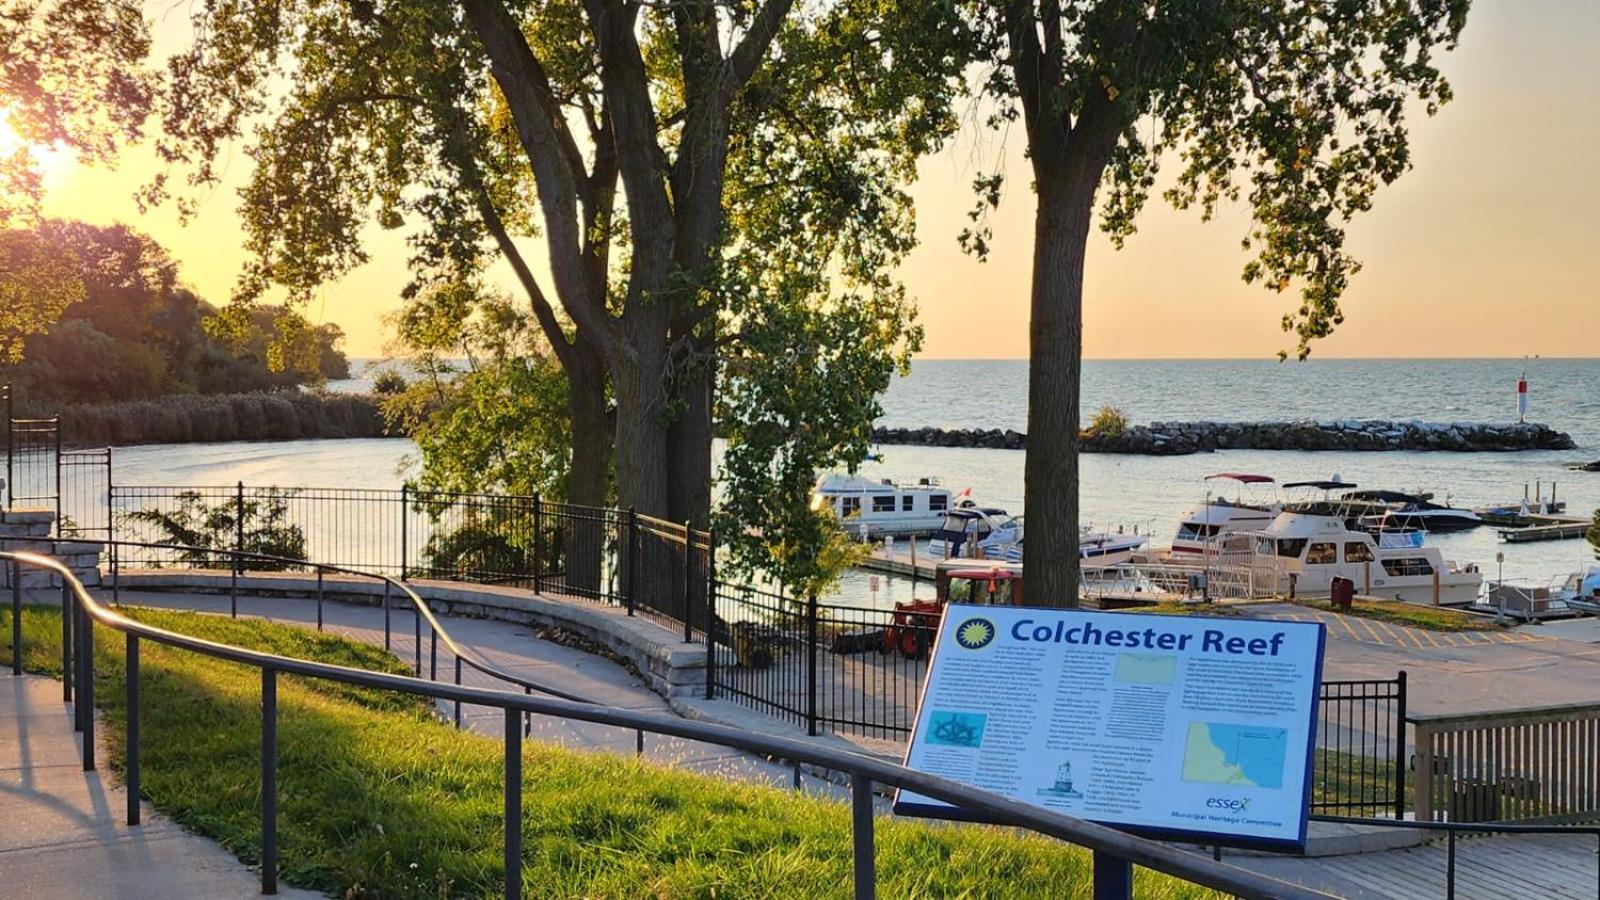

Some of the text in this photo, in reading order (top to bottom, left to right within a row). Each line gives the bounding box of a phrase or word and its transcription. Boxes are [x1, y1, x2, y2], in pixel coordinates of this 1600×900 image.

[1011, 619, 1285, 656] Colchester Reef
[1206, 797, 1251, 813] essex
[1171, 811, 1206, 820] Municipal
